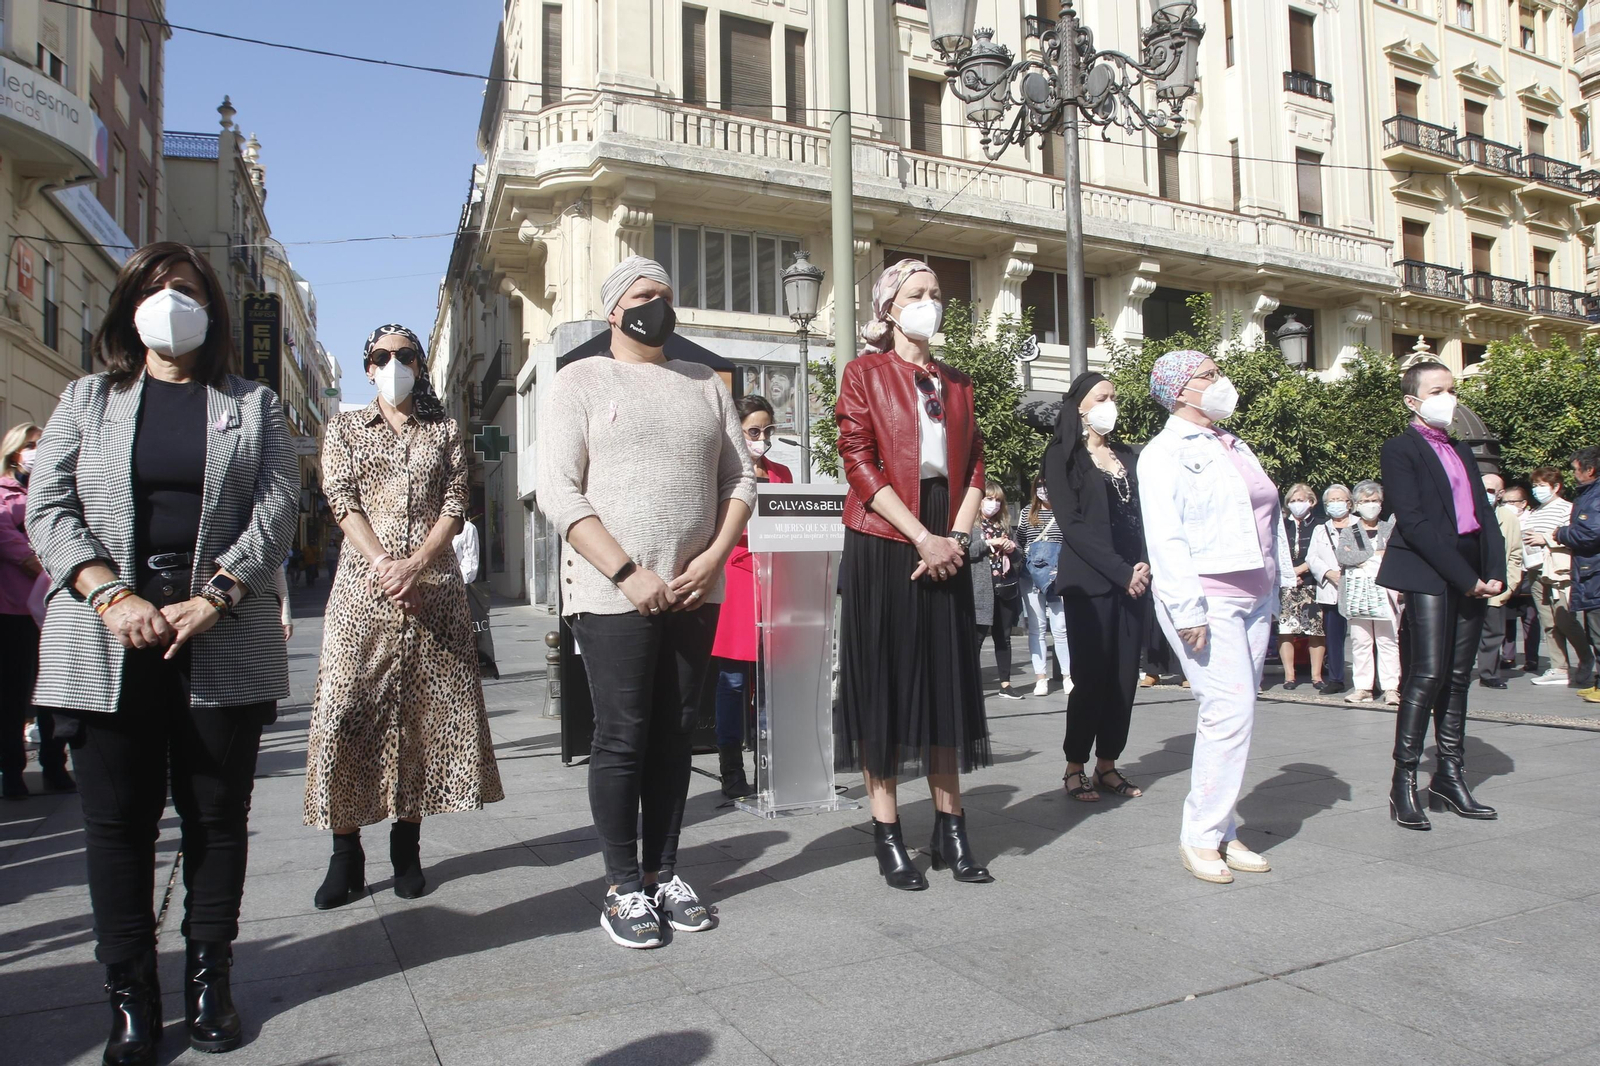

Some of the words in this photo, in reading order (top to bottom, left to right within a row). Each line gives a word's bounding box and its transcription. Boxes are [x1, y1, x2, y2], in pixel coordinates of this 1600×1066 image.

[3, 67, 79, 124] ledesma
[629, 323, 647, 335] Puedes
[774, 523, 804, 533] MUJERES
[805, 523, 818, 532] QUE
[819, 523, 829, 532] SE
[684, 906, 706, 916] ELVIS
